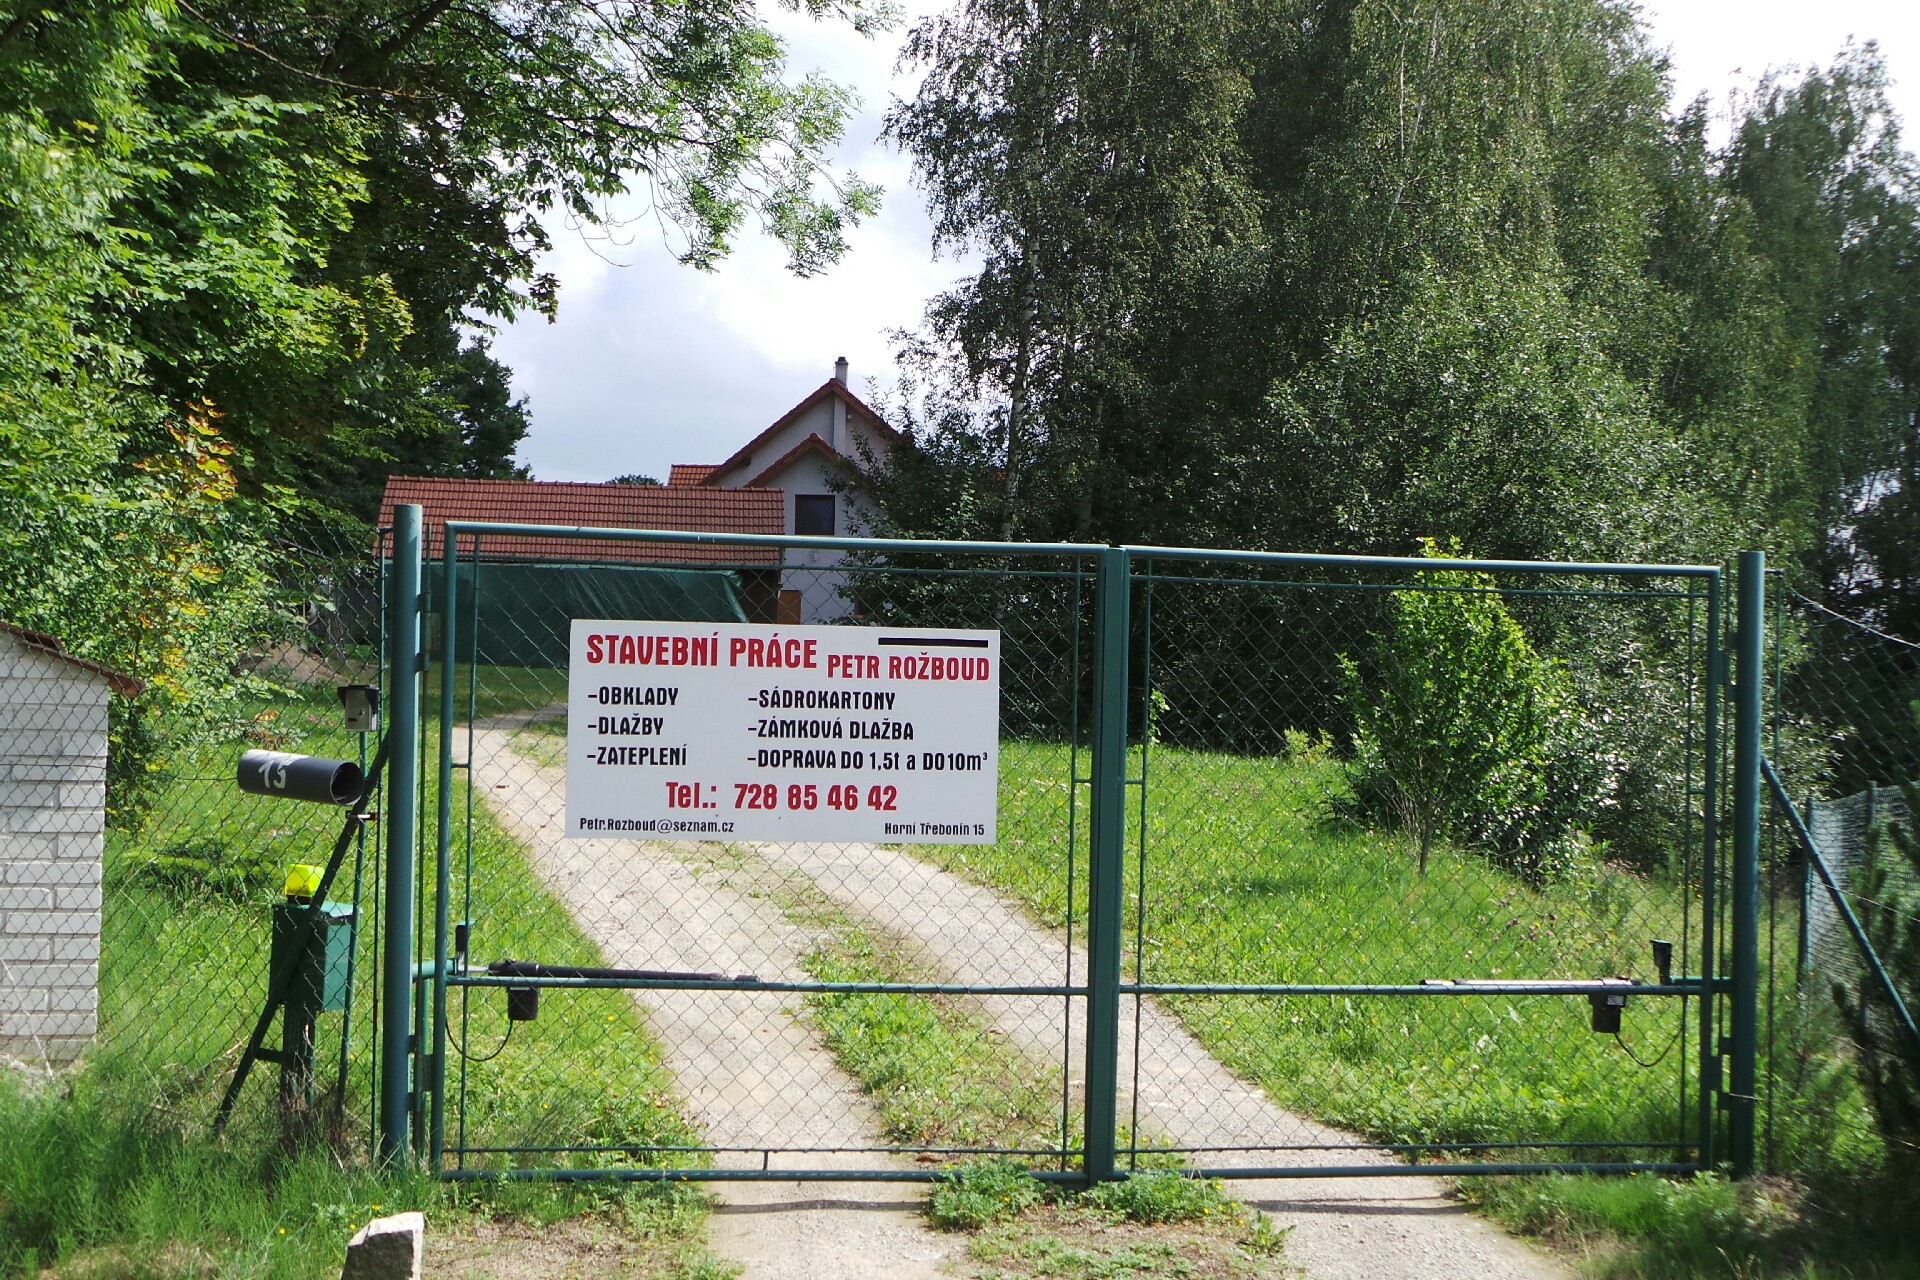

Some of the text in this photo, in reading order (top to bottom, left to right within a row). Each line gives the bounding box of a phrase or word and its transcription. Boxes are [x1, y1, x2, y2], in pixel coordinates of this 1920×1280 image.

[587, 632, 817, 668] STAVEBNÍ PRÁCE
[828, 653, 989, 680] PETR ROŽBOUD
[588, 686, 678, 705] -OBKLADY
[748, 686, 895, 710] -SÁDROKARTONY
[588, 713, 663, 735] -DLAŽBY
[748, 716, 913, 740] -ZÁMKOVÁ DLAŽBA
[587, 744, 687, 765] -ZATEPLENÍ
[748, 750, 836, 768] -DOPRAVA
[870, 752, 899, 771] 1,5t
[907, 755, 915, 770] a
[666, 782, 897, 810] Tel.: 728 85 46 42
[580, 818, 734, 833] Petr.Rozboud@seznam.cz
[885, 823, 984, 835] Horní Třebonín 15
